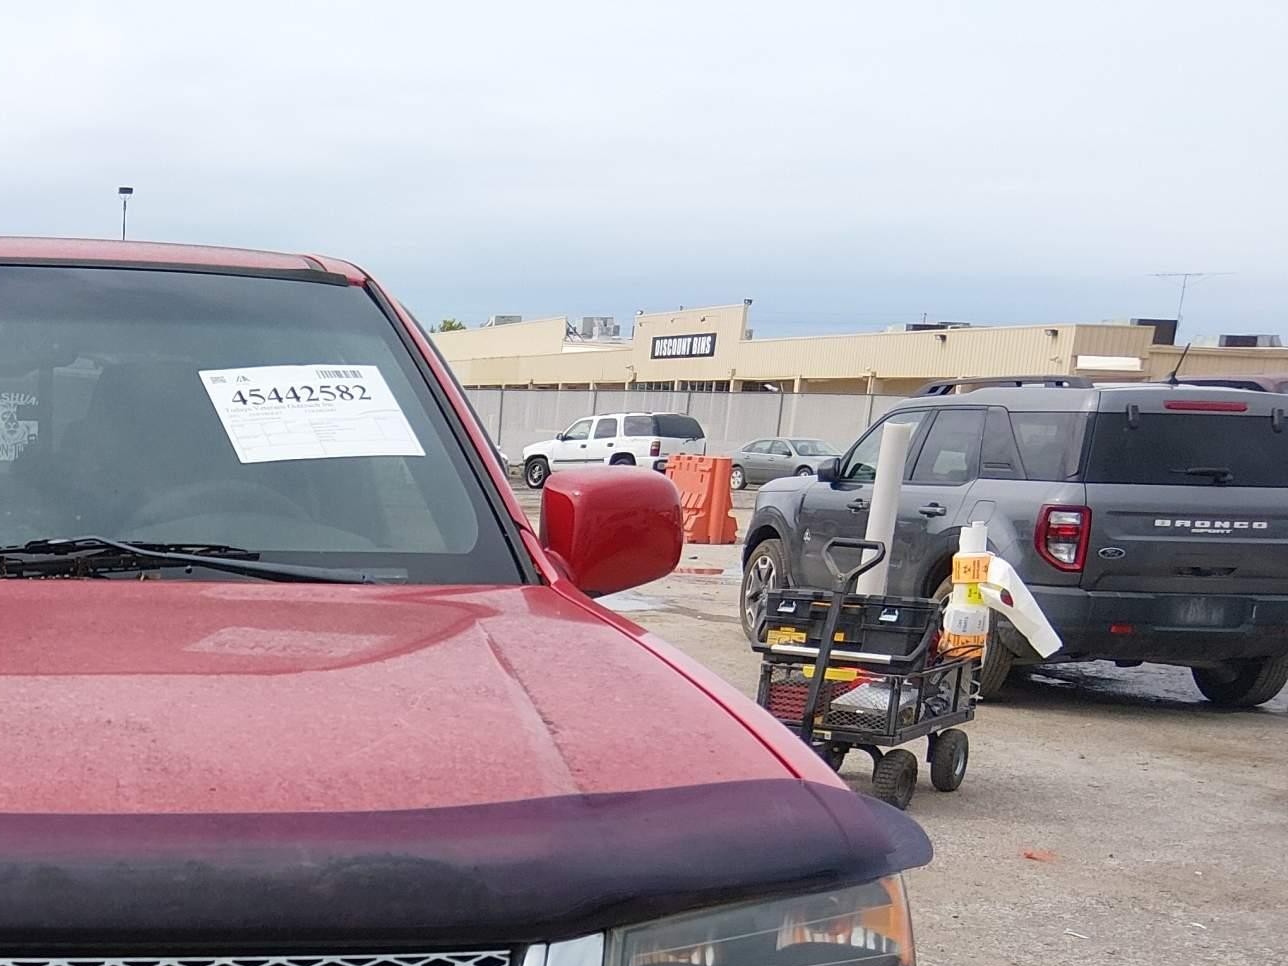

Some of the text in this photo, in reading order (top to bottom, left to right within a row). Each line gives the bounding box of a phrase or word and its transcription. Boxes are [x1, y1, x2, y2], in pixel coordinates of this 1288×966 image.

[654, 336, 712, 357] DISCOUNT BINS
[231, 384, 372, 405] 45442582
[1154, 519, 1268, 529] BRONCO
